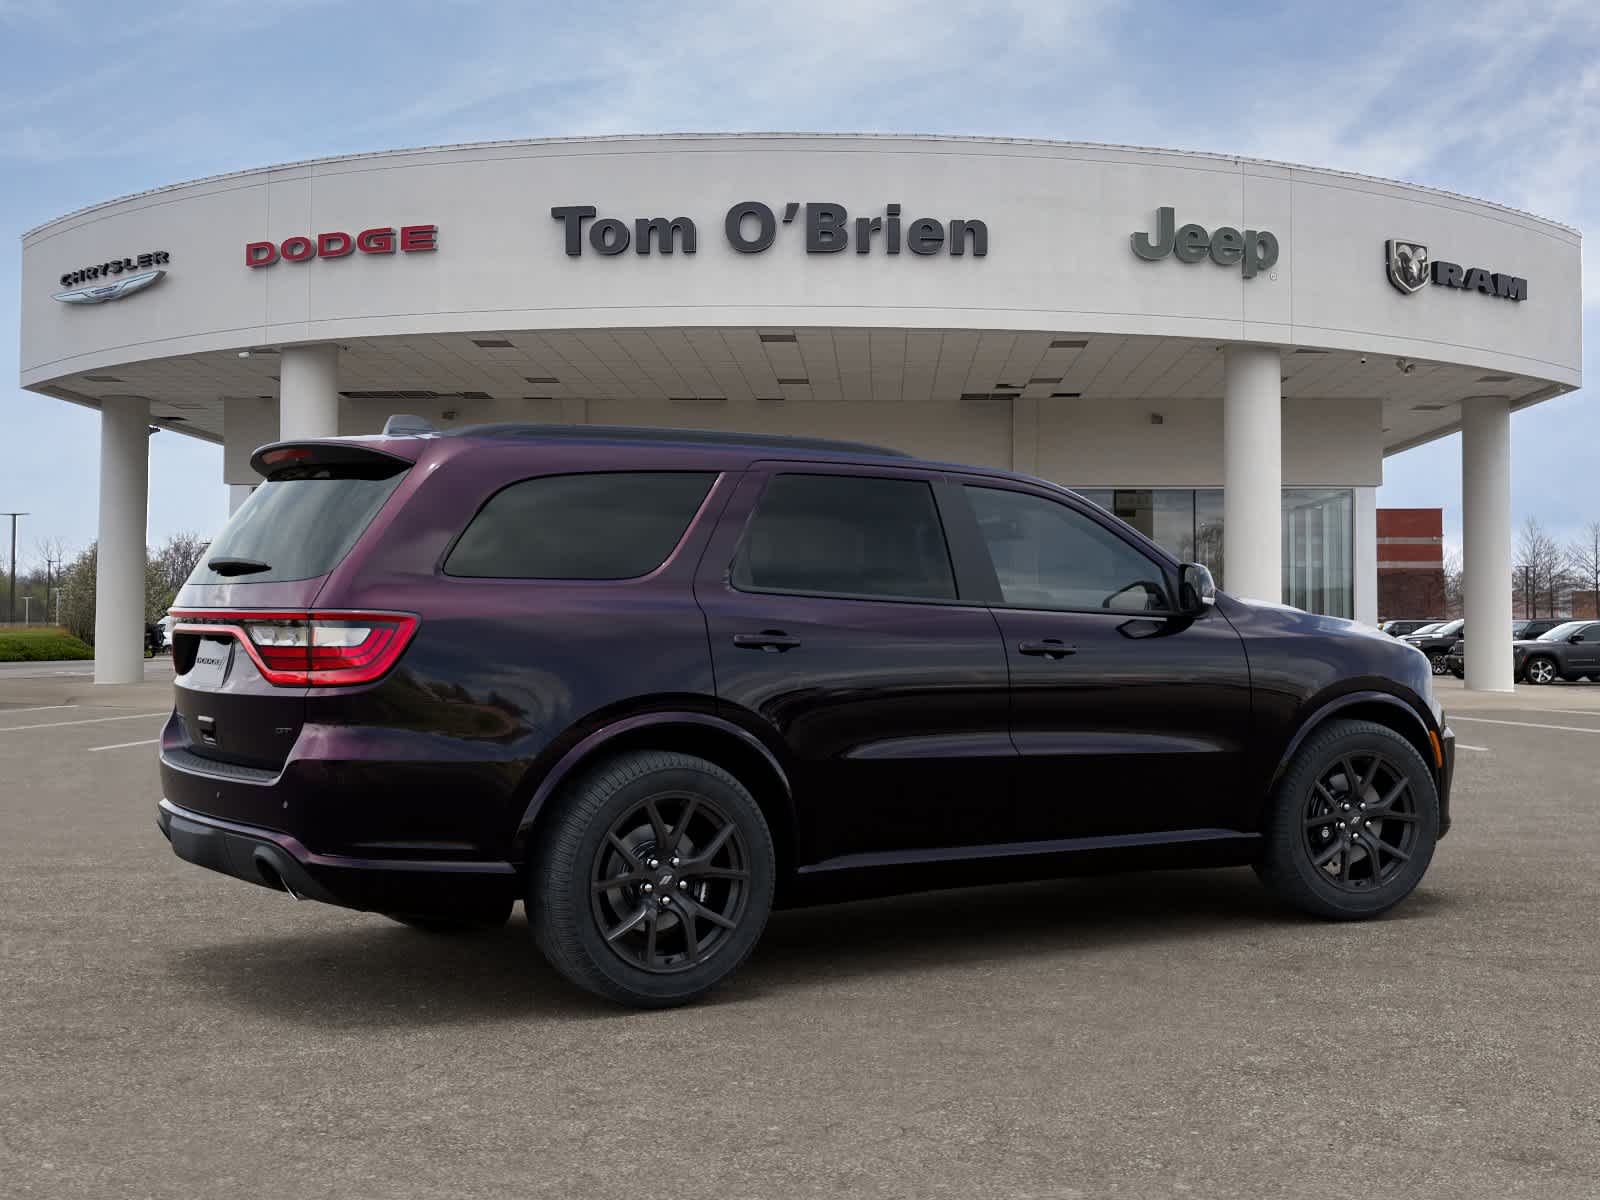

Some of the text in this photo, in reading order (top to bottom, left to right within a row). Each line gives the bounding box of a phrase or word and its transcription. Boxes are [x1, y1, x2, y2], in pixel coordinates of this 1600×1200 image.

[245, 224, 438, 269] DODGE
[551, 201, 988, 257] Tom O'Brien
[1131, 206, 1280, 279] Jeep
[60, 249, 170, 287] CHRYSLER
[1430, 260, 1528, 303] RAM
